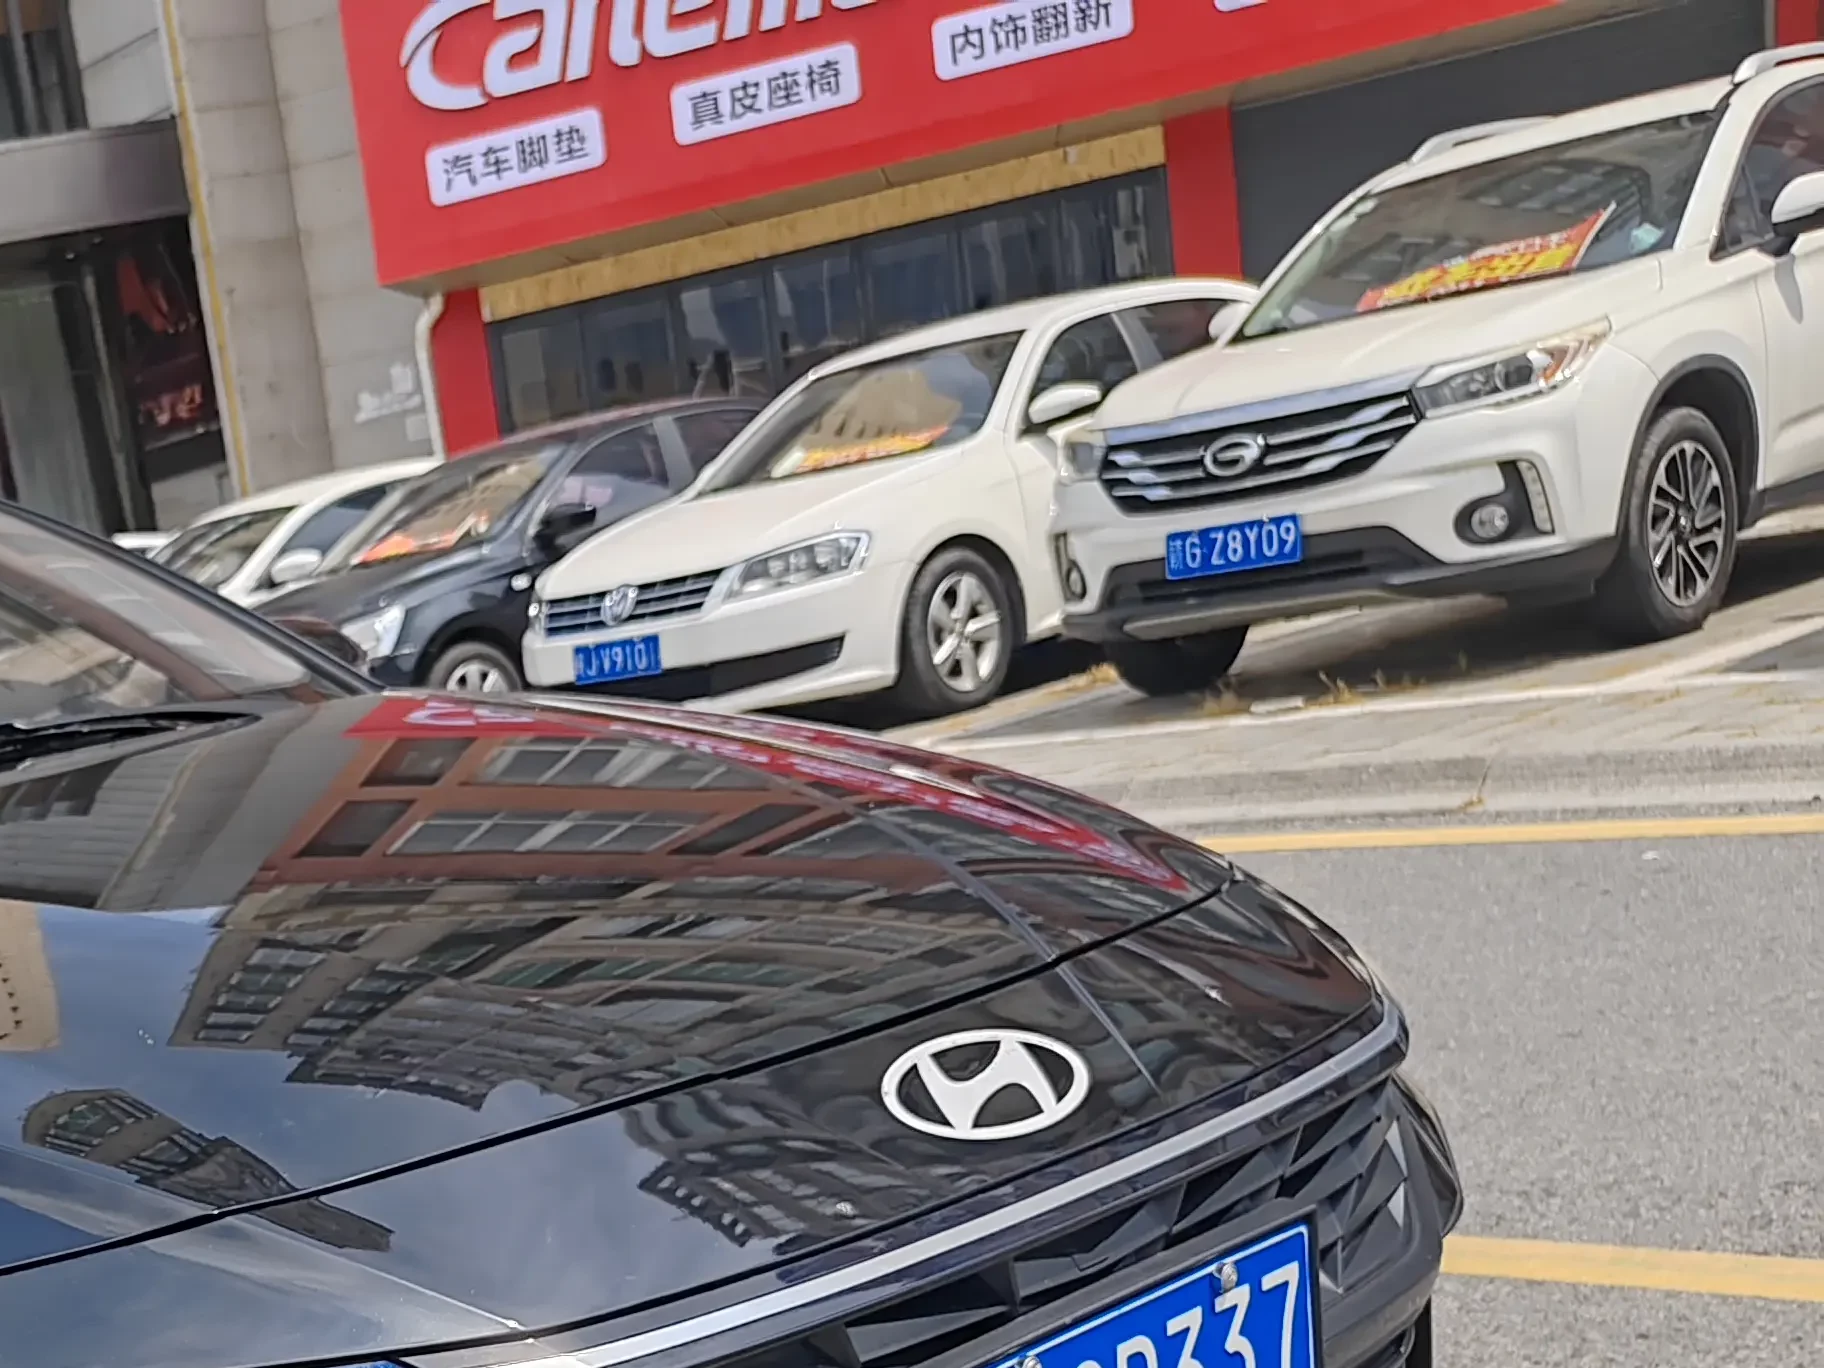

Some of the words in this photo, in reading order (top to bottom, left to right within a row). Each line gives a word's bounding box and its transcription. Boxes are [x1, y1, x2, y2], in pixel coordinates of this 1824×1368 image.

[949, 0, 1113, 65] 内饰翻新
[687, 58, 843, 131] 真皮座椅
[442, 125, 590, 193] 汽车脚垫
